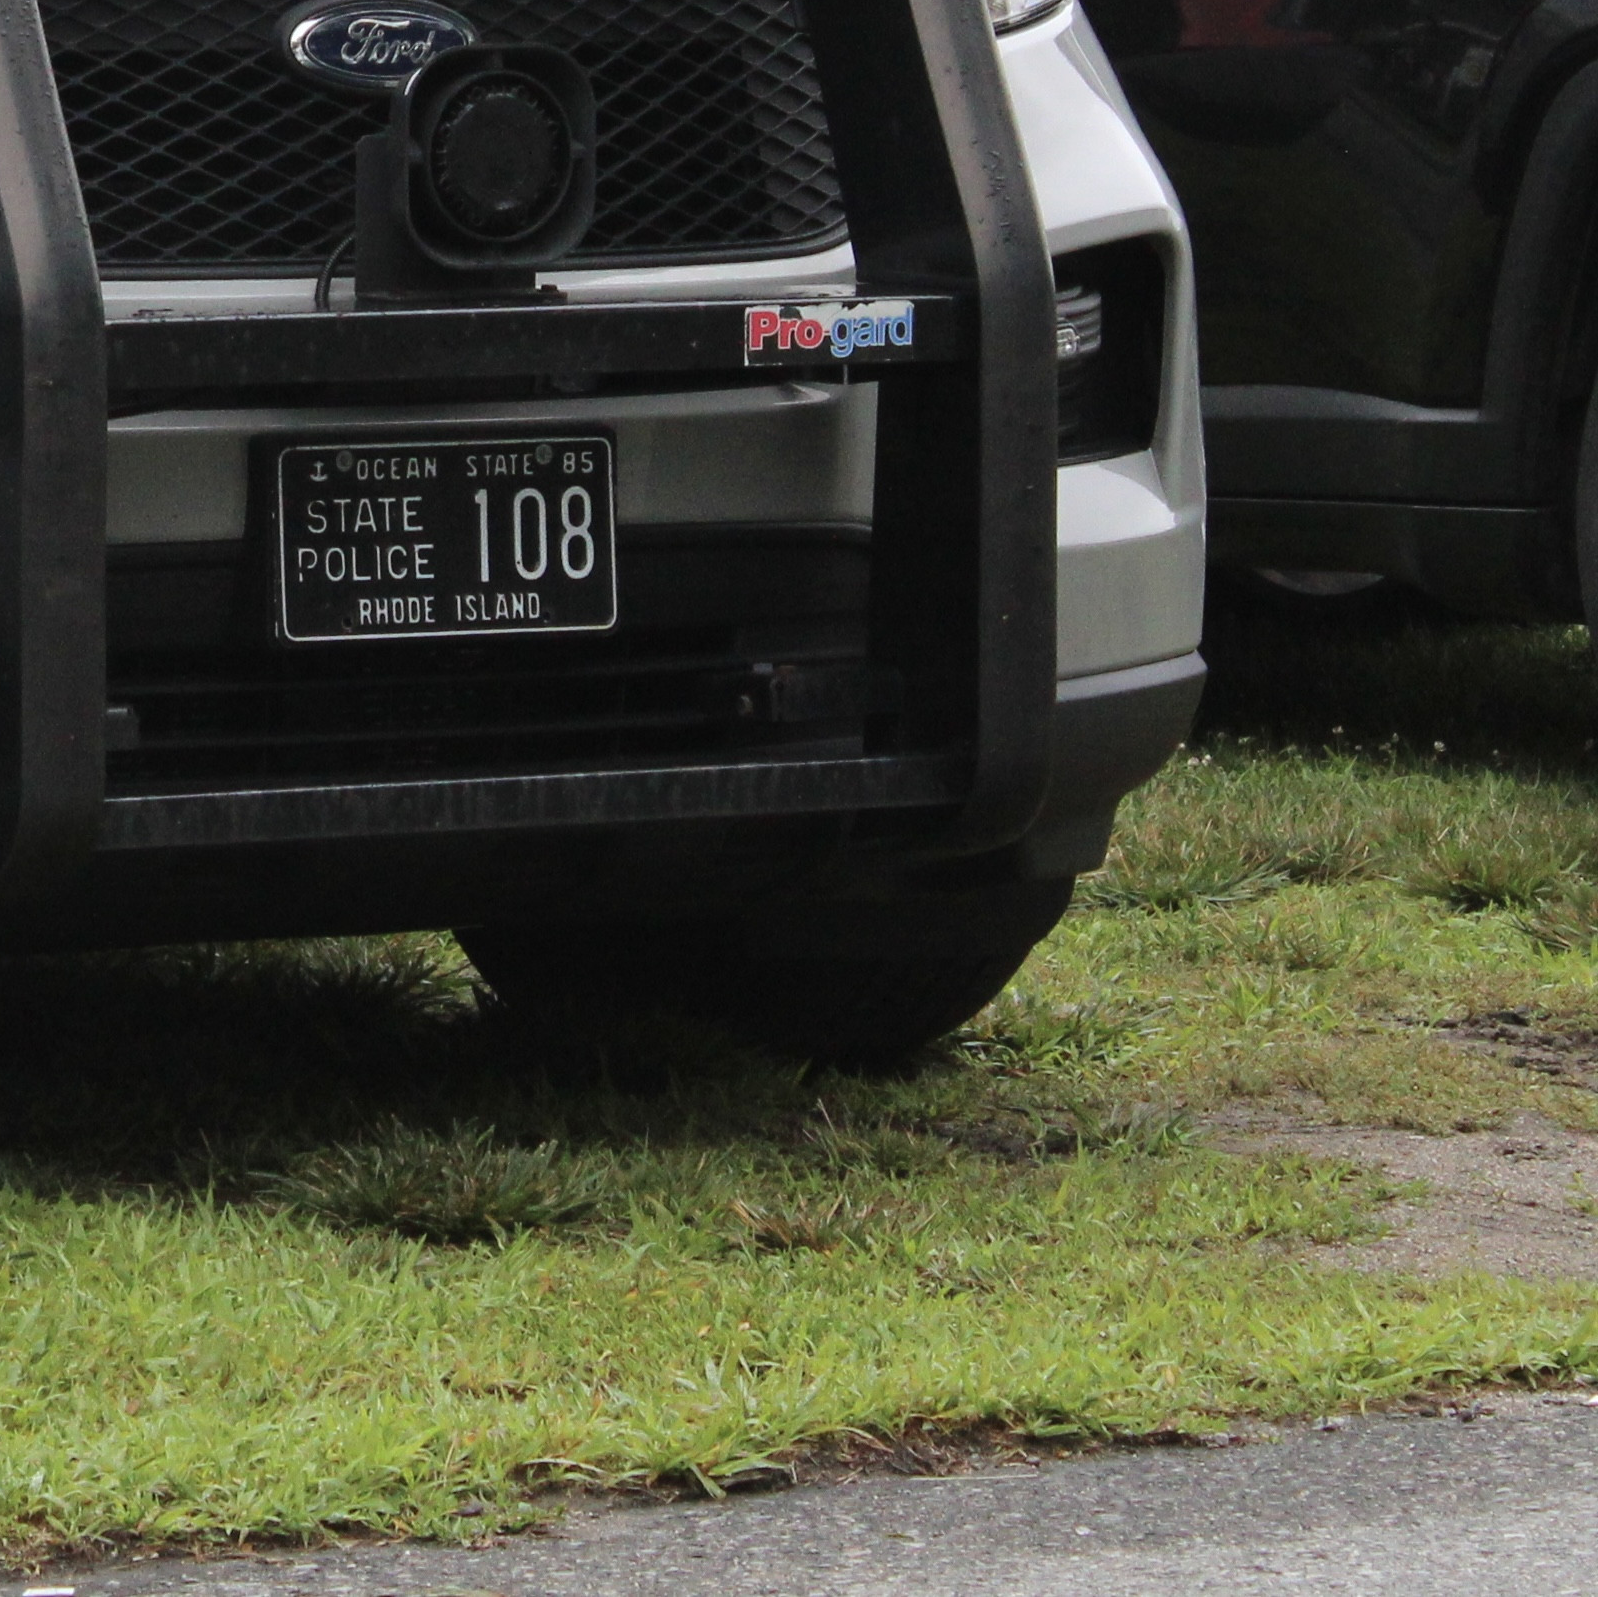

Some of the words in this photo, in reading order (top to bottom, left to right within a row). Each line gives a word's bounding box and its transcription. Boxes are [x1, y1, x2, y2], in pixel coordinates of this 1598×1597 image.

[340, 18, 436, 66] Ford
[749, 306, 914, 358] Pro-gard
[356, 457, 437, 481] OCEAN
[466, 454, 535, 477] STATE
[562, 452, 594, 474] 85
[307, 496, 424, 534] STATE
[474, 485, 595, 582] 108
[298, 544, 435, 582] POLICE
[358, 596, 436, 625] RHODE
[455, 593, 541, 622] ISLAND
